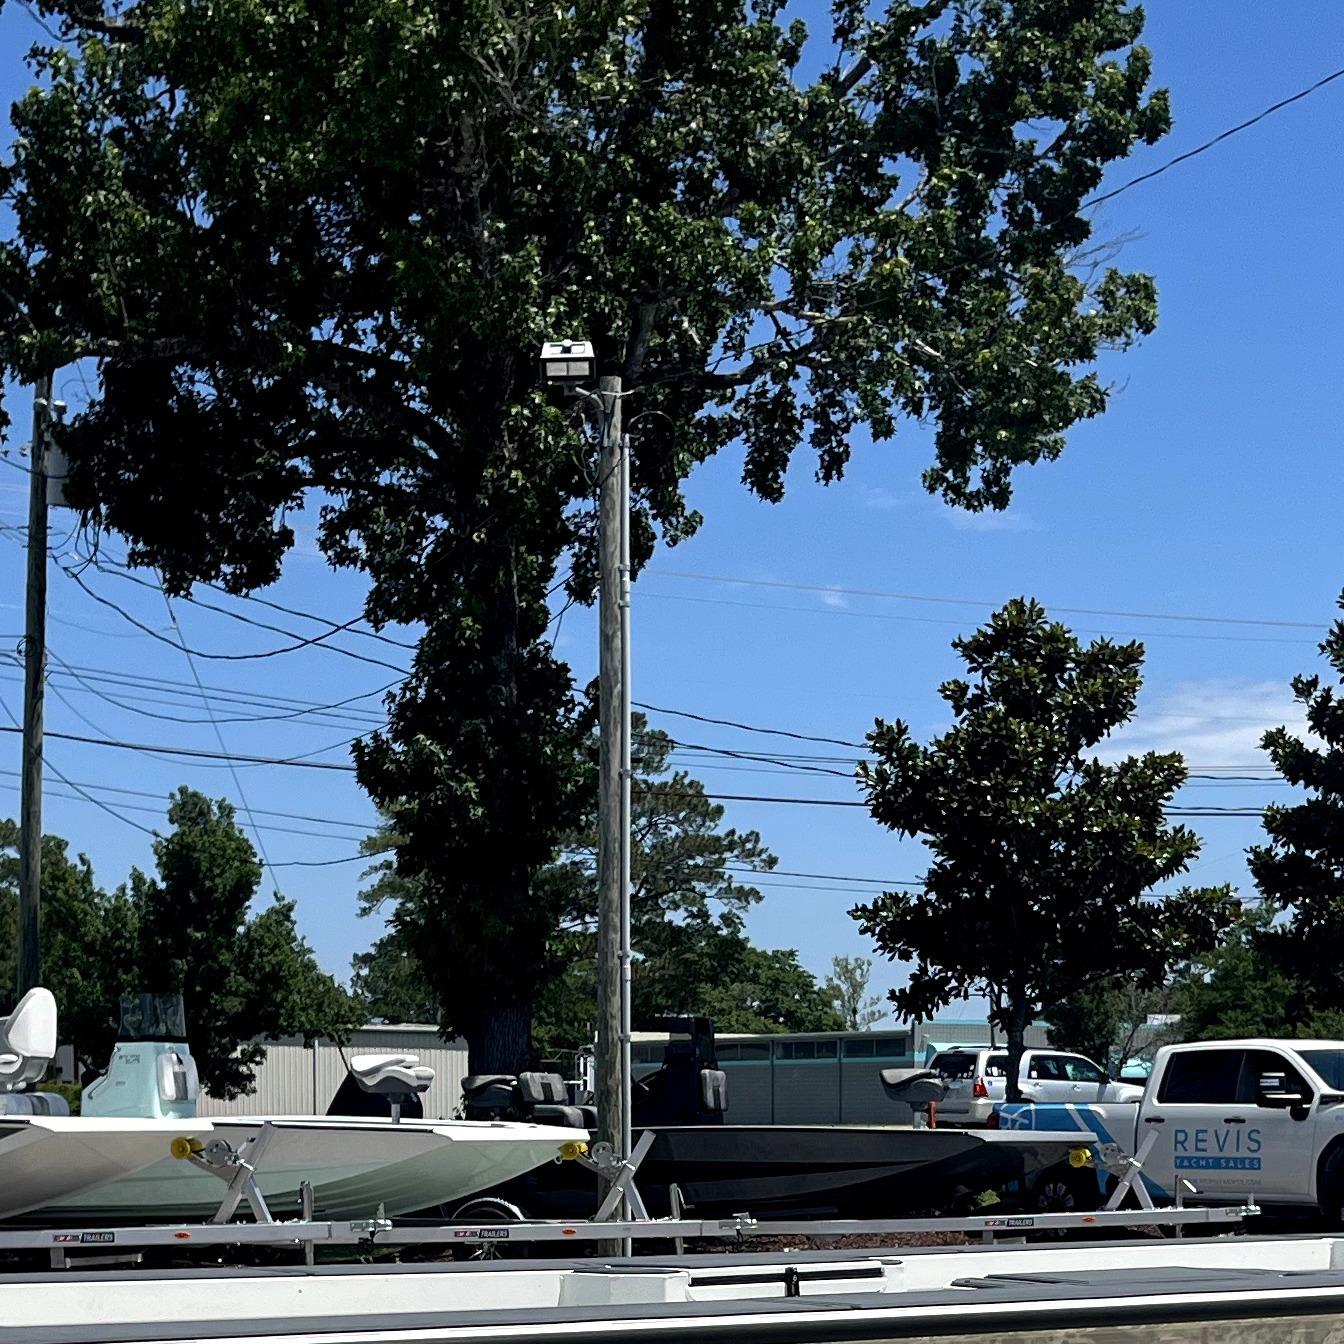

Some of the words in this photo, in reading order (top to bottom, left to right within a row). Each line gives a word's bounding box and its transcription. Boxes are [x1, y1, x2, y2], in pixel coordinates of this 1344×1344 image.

[1173, 1128, 1262, 1153] REVIS
[1175, 1158, 1214, 1167] YACHT
[1219, 1158, 1260, 1169] SALES
